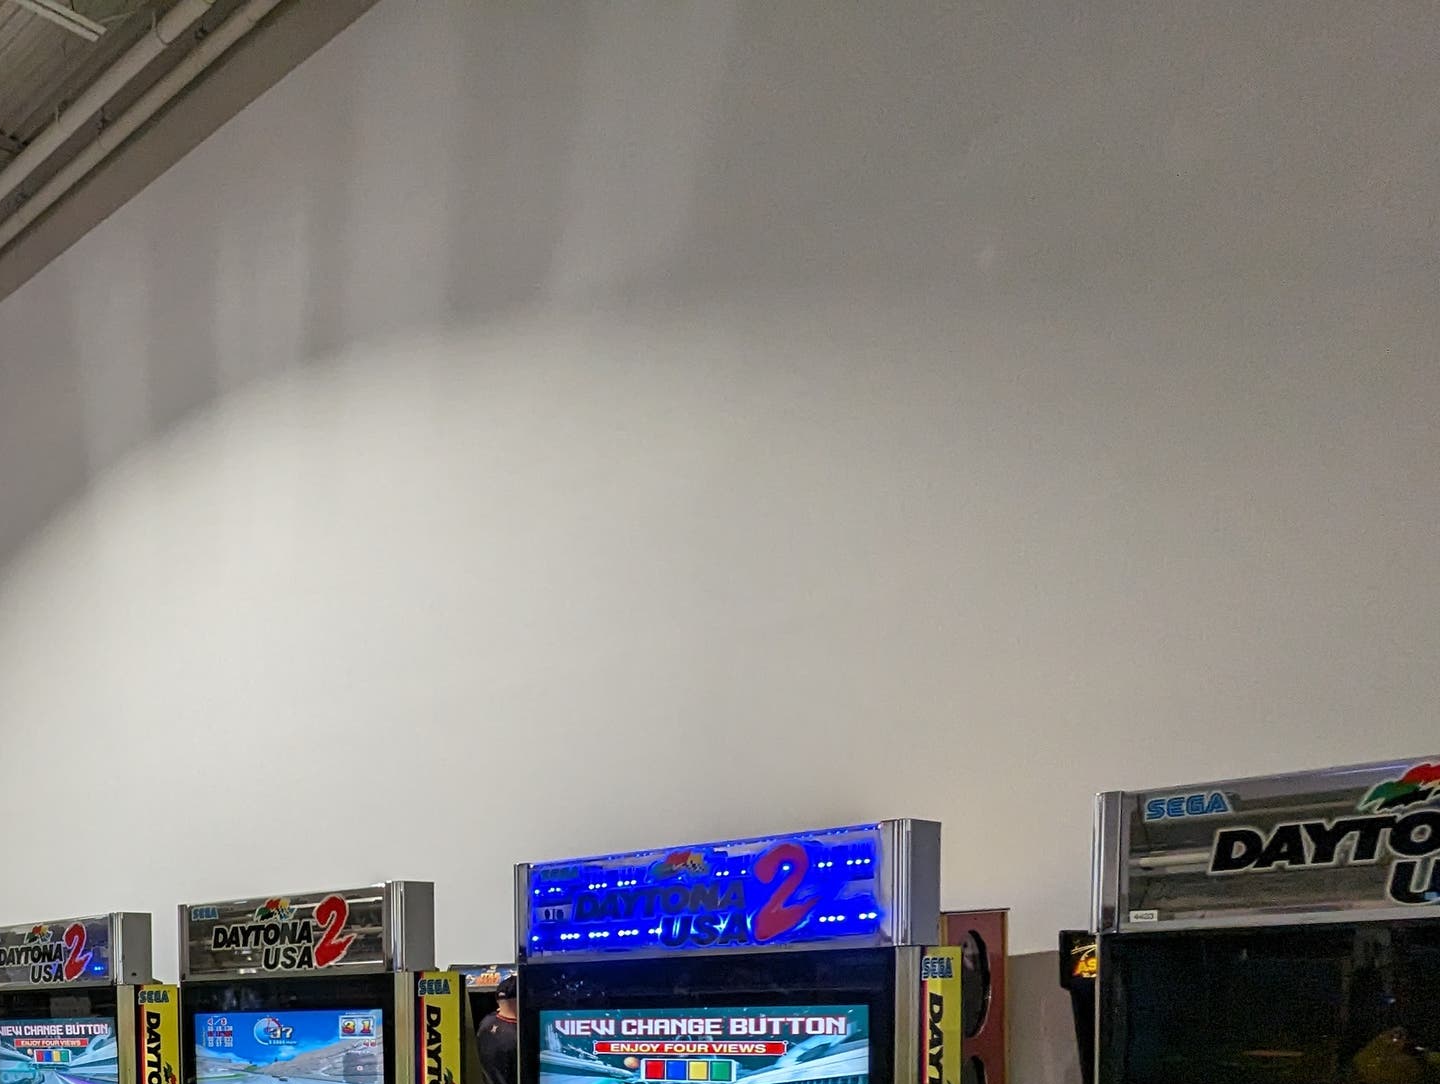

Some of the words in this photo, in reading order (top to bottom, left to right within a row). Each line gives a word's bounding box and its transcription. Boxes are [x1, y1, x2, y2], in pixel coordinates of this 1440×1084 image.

[1145, 791, 1232, 822] SEGA
[1208, 808, 1440, 876] DAYTO
[573, 879, 747, 923] DAYTONA
[752, 842, 820, 941] 2
[191, 906, 219, 921] SEGA
[211, 919, 314, 951] DAYTONA
[313, 894, 357, 969] 2
[661, 912, 749, 947] USA
[62, 922, 94, 981] 2
[262, 945, 315, 971] USA
[30, 962, 64, 984] USA
[922, 956, 953, 981] SEGA
[138, 990, 169, 1004] SEGA
[417, 978, 451, 996] SEGA
[24, 1024, 64, 1036] CHANGE
[65, 1023, 109, 1036] BUTTON
[555, 1018, 615, 1037] VIEW
[621, 1017, 724, 1036] CHANGE
[729, 1016, 848, 1036] BUTTON
[610, 1043, 661, 1054] ENJOY
[663, 1043, 709, 1054] FOUR
[711, 1043, 767, 1054] VIEWS
